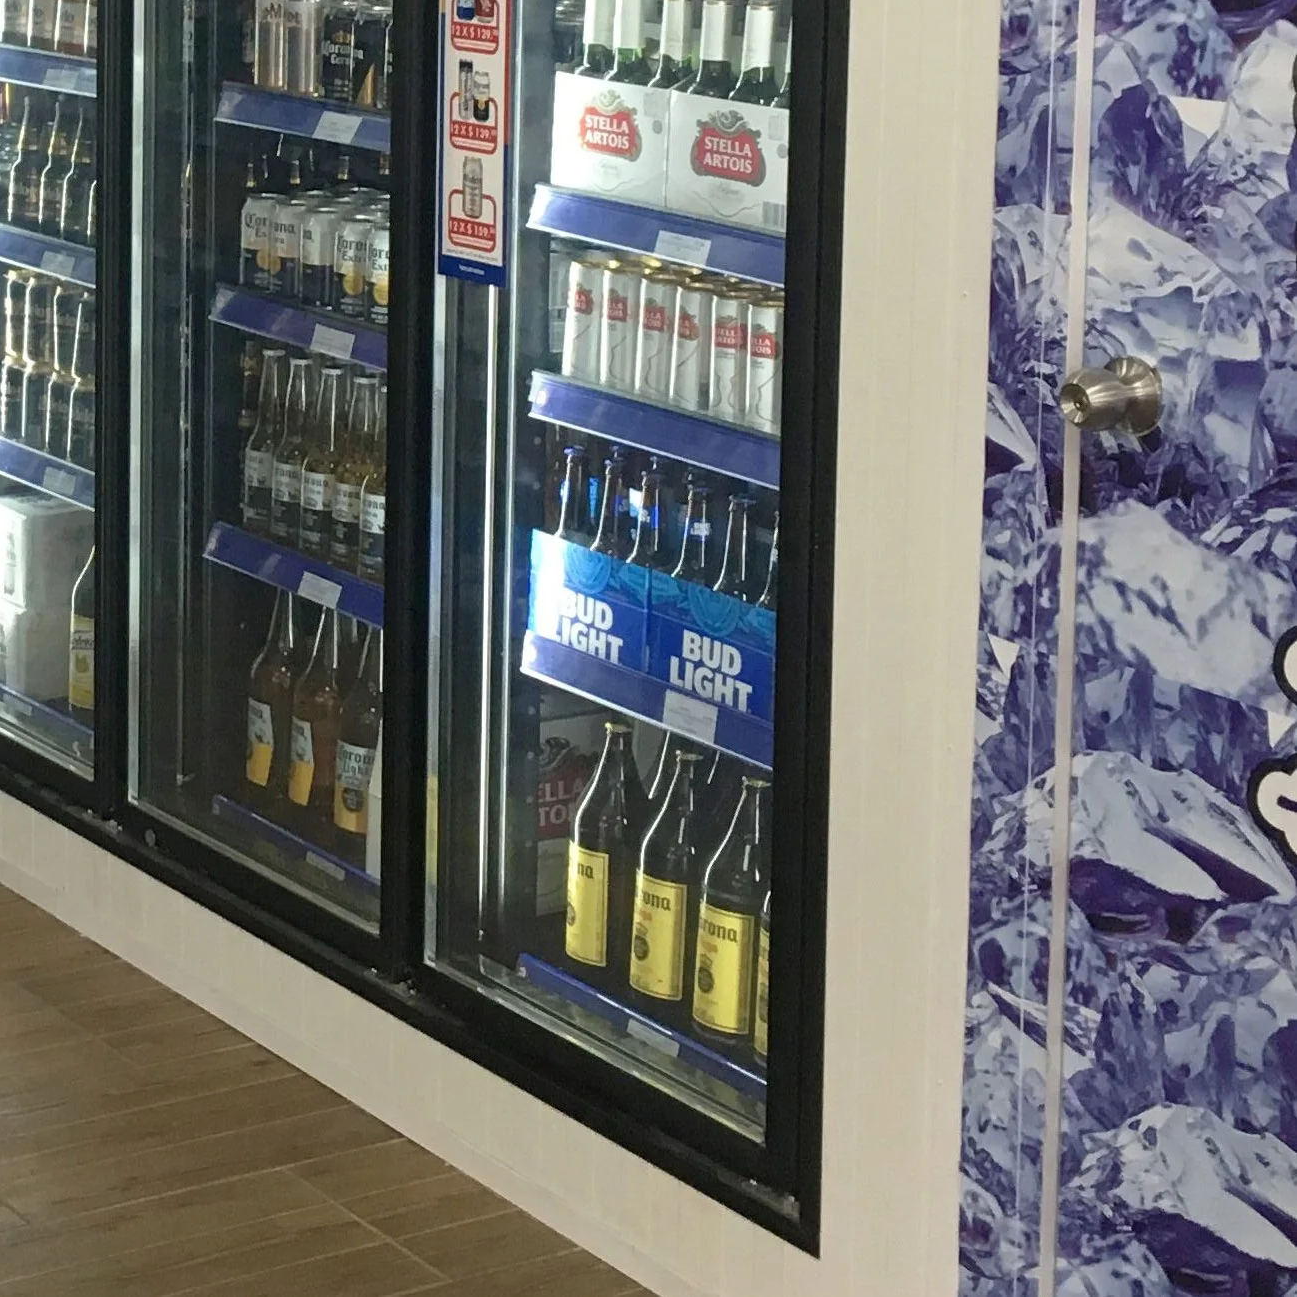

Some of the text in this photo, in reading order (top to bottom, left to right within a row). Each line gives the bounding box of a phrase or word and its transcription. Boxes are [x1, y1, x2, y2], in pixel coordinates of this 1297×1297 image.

[584, 114, 629, 134] STELLA
[584, 129, 630, 150] ARTOIS
[704, 135, 752, 157] STELLA
[703, 152, 753, 174] ARTOIS
[559, 587, 614, 631] BUD
[554, 616, 624, 666] LIGHT
[681, 628, 742, 677] BUD
[669, 655, 753, 713] LIGHT
[702, 916, 738, 944] rona
